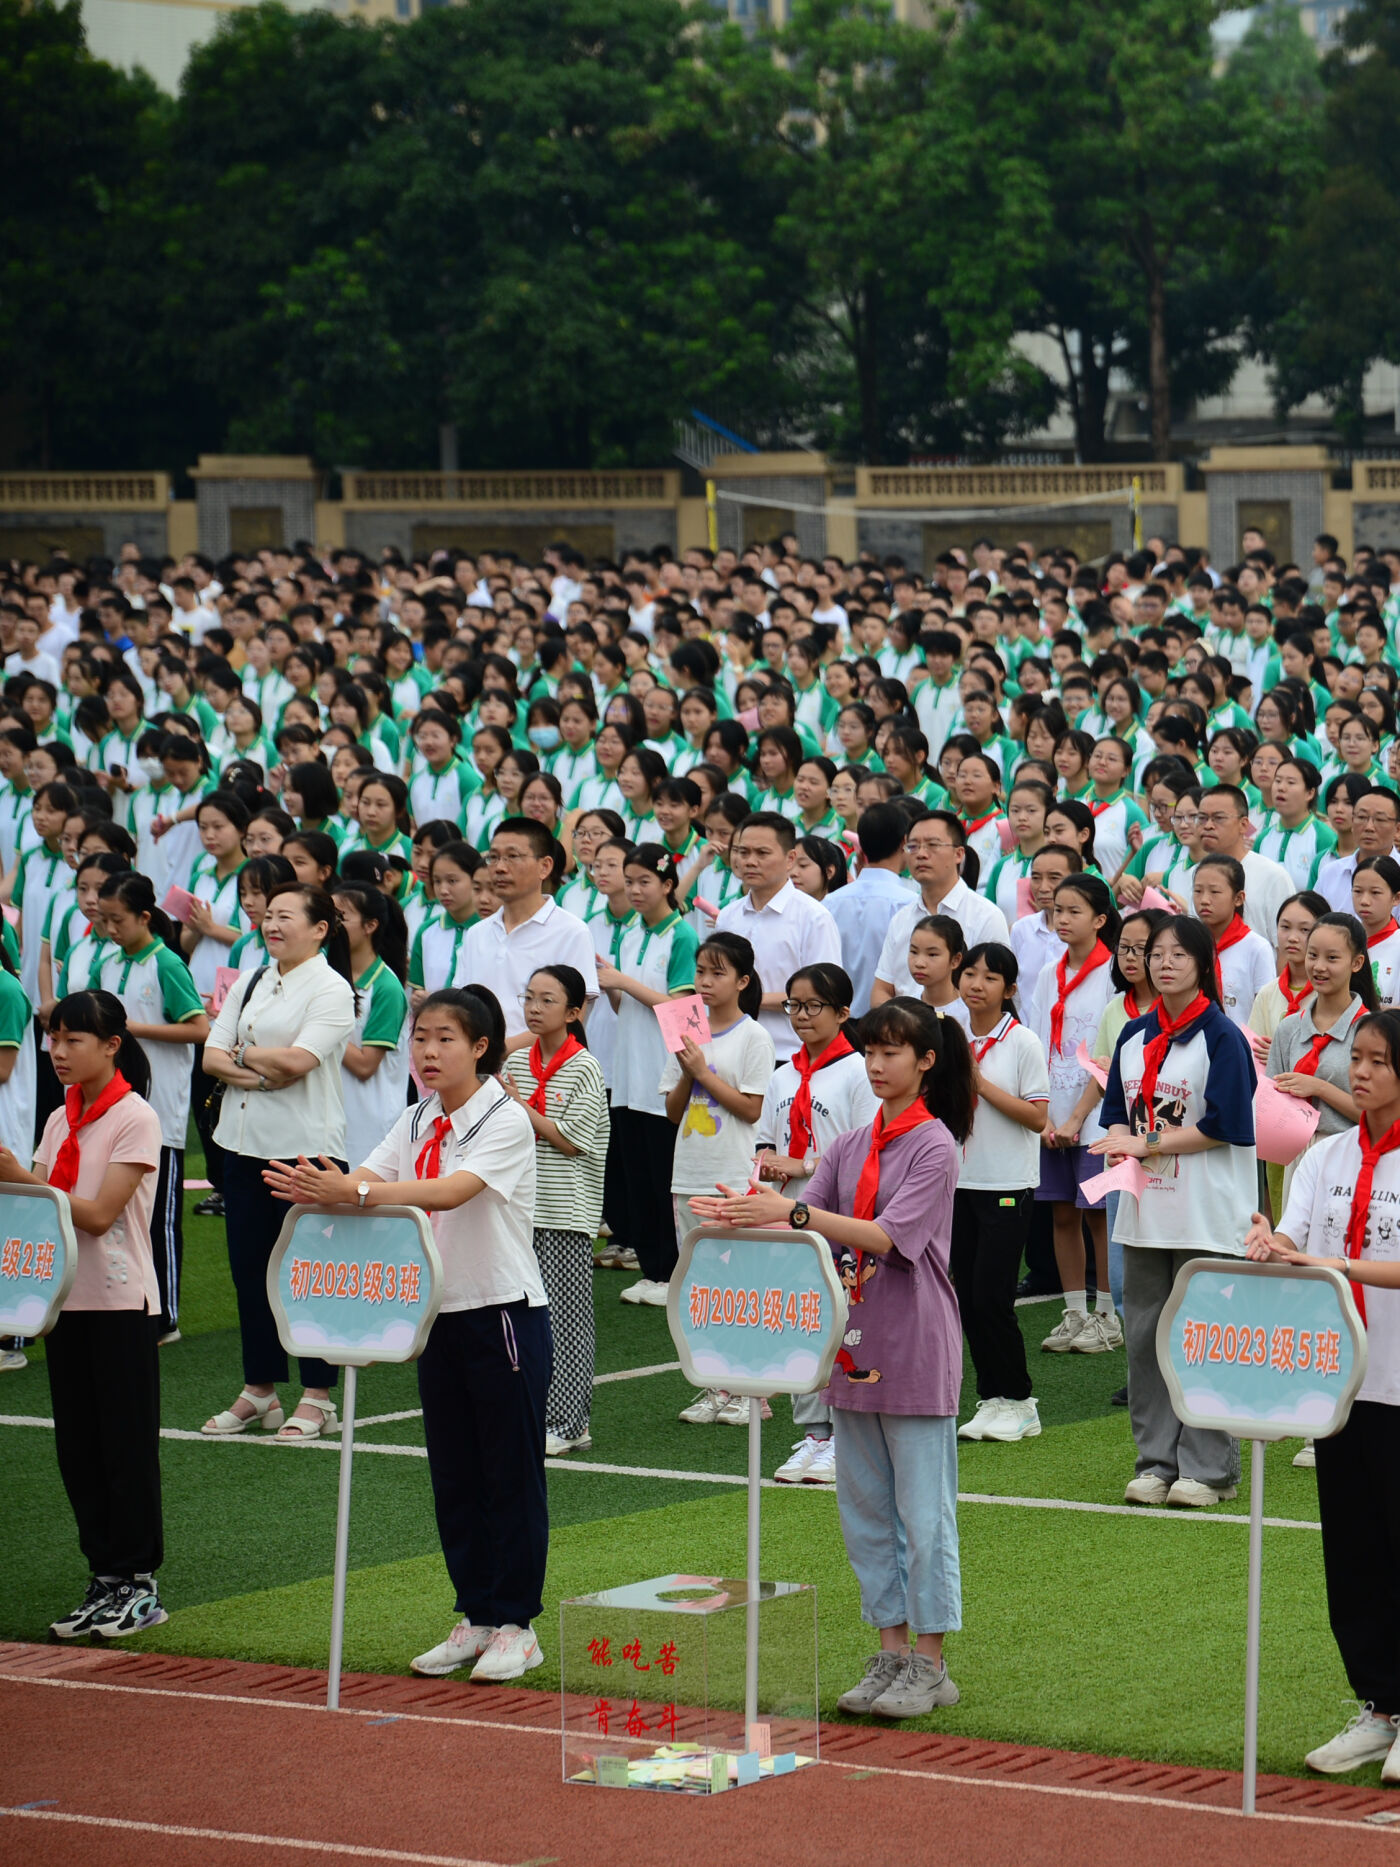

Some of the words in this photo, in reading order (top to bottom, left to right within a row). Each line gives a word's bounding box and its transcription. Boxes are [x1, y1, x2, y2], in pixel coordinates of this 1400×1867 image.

[289, 1257, 421, 1307] 初2023级3班
[689, 1283, 822, 1336] 初2023级4班
[1182, 1318, 1341, 1377] 初2023级5班
[587, 1637, 681, 1676] 能吃苦
[588, 1698, 681, 1742] 肯奋斗
